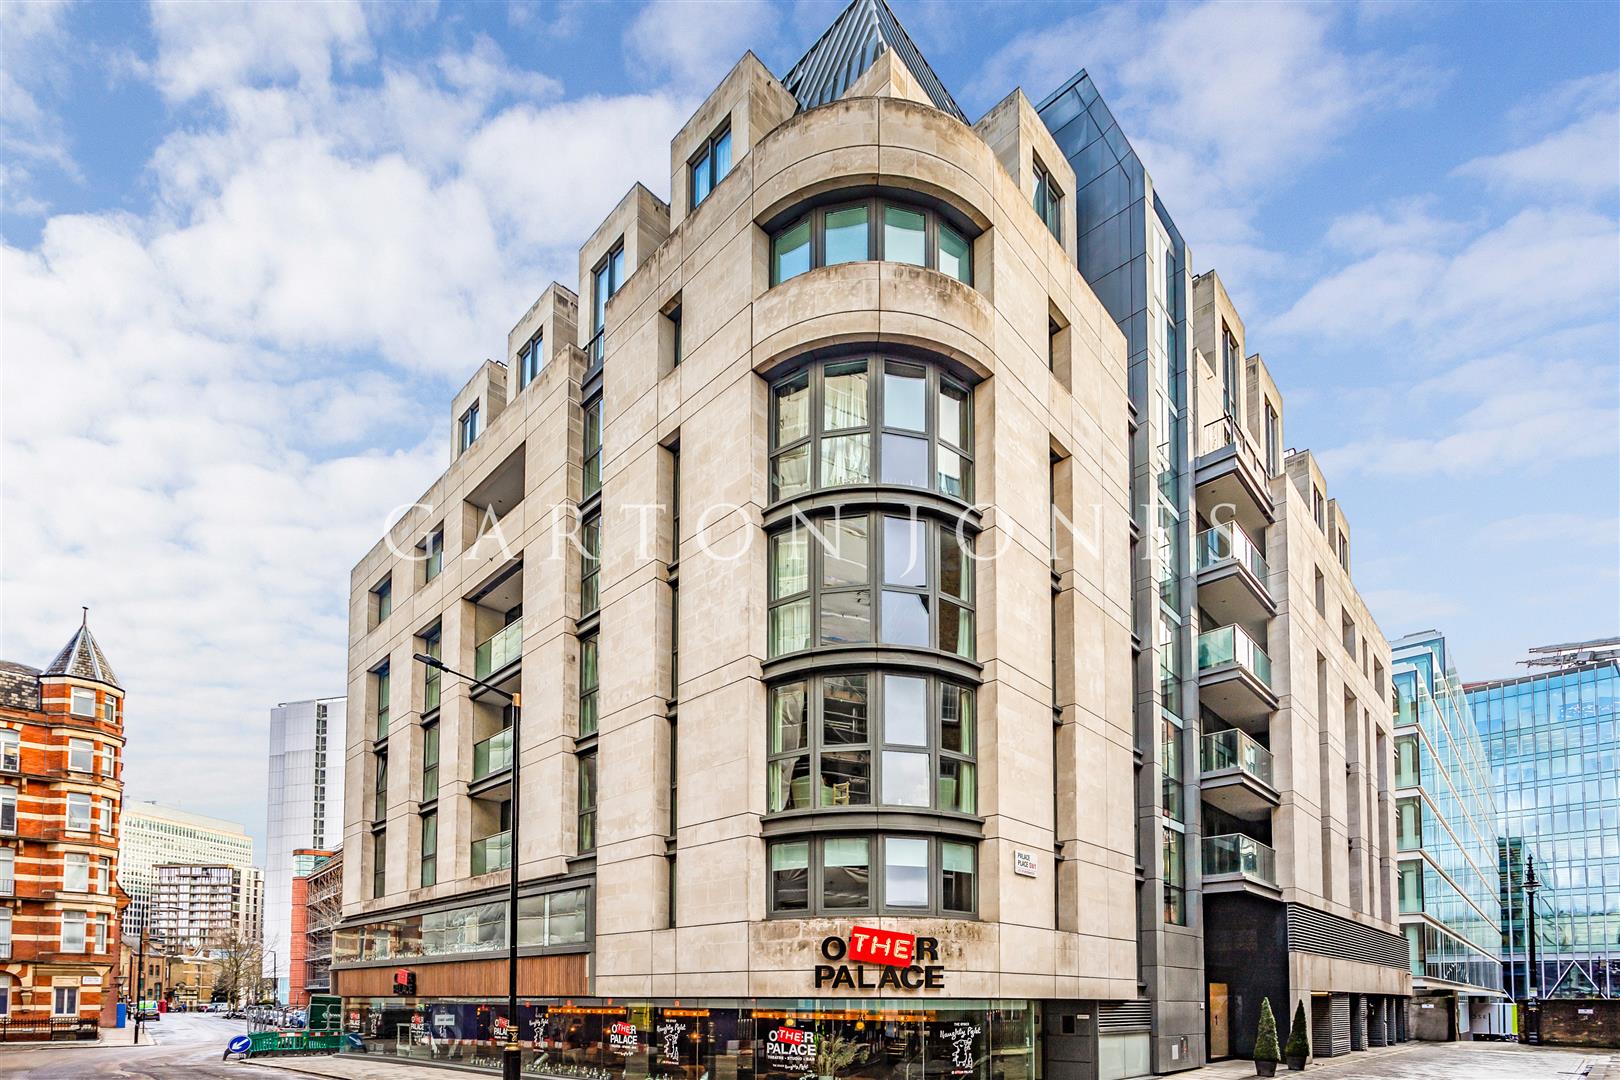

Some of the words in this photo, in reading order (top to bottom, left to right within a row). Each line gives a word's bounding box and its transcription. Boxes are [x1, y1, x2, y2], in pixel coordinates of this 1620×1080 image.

[815, 965, 945, 989] PALACE
[610, 1034, 638, 1045] PALACE
[766, 1042, 817, 1056] PALACE
